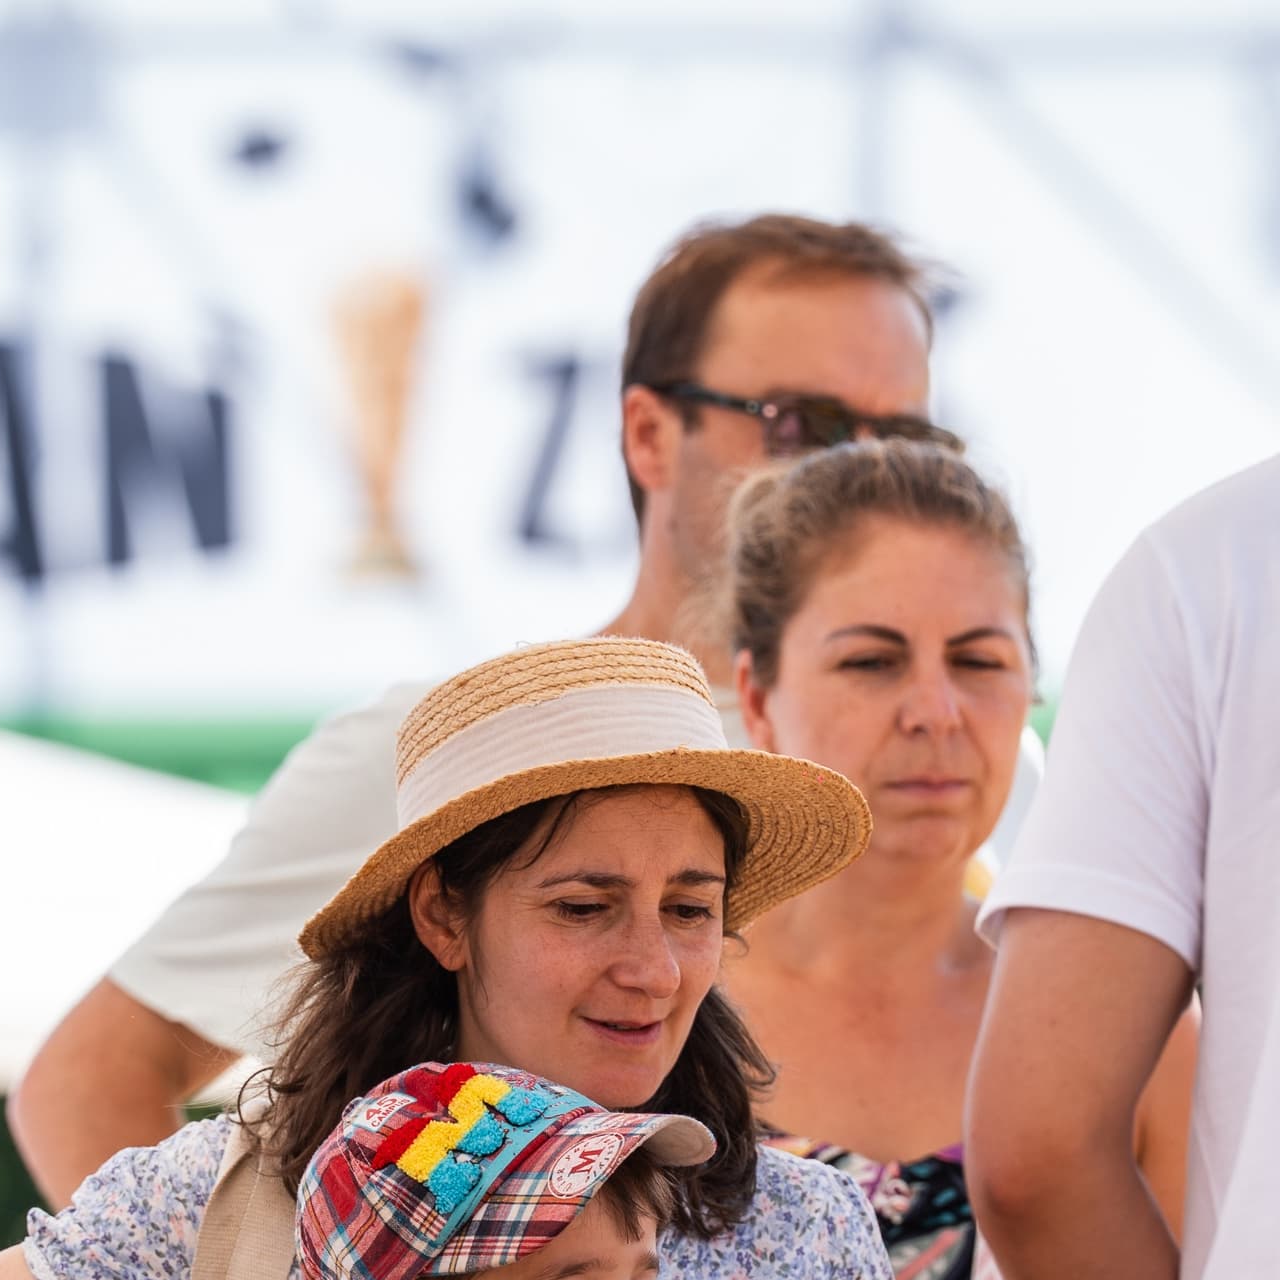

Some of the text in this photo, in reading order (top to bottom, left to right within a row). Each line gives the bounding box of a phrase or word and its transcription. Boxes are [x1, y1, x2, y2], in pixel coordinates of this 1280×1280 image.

[366, 1097, 397, 1120] 45
[371, 1099, 411, 1127] CAMPUS
[568, 1147, 604, 1177] M
